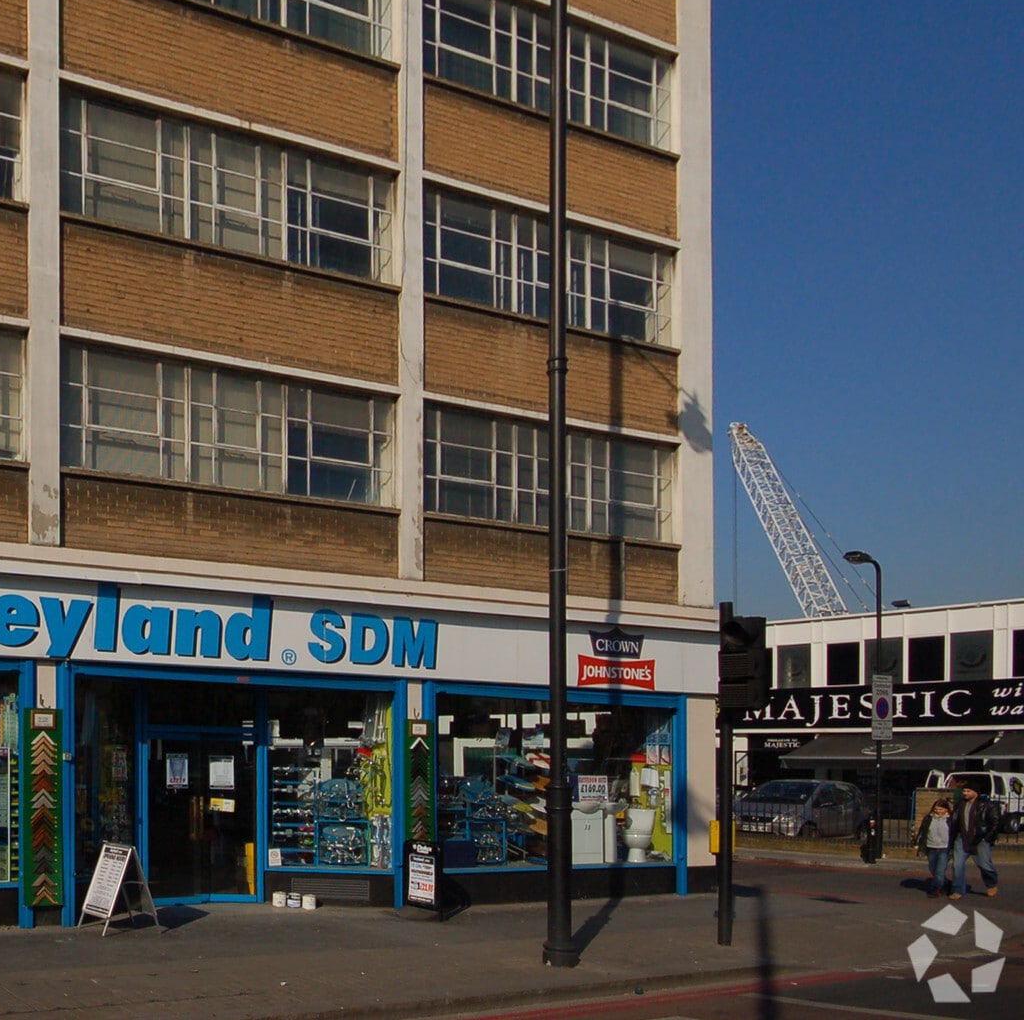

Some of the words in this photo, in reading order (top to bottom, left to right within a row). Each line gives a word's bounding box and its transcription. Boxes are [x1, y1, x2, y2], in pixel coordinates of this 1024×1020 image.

[309, 609, 441, 670] SDM
[595, 639, 639, 653] CROWN
[581, 664, 652, 682] JOHNSTONE'S
[743, 689, 972, 727] MAJESTIC
[764, 741, 801, 749] MAJESTIC
